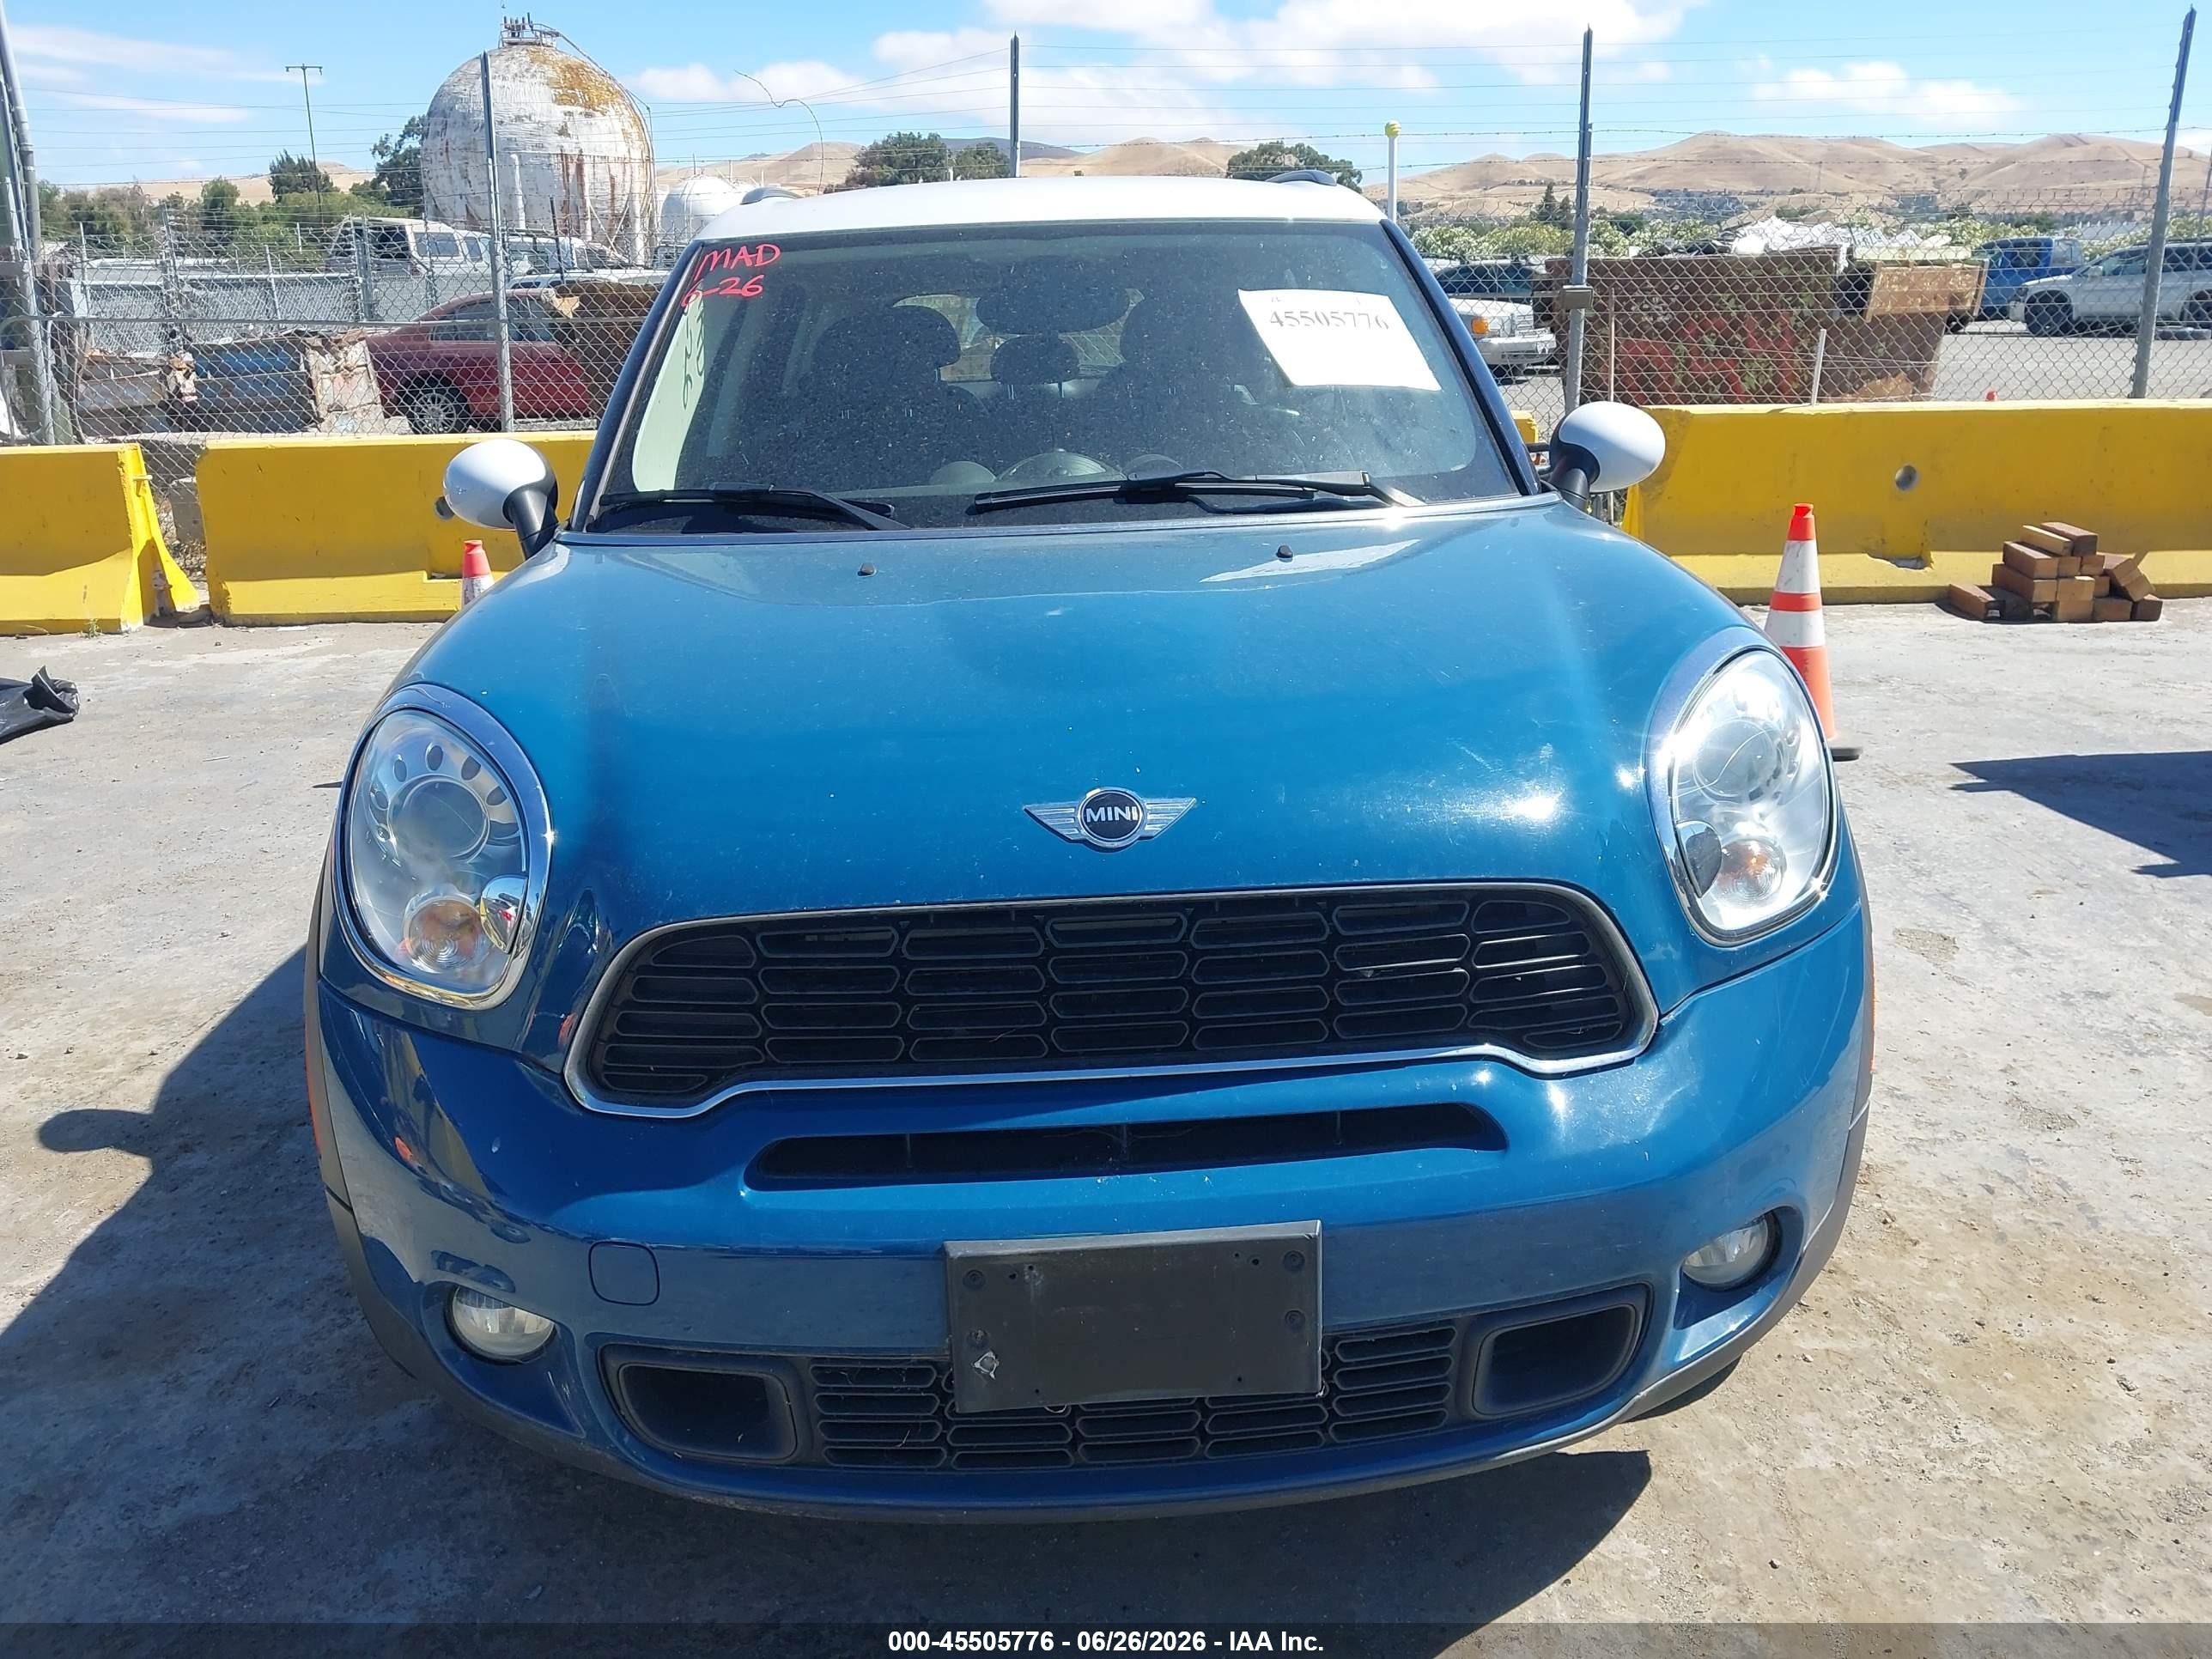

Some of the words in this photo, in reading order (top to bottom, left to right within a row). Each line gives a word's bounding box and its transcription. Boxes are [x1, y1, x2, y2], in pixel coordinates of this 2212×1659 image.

[693, 244, 781, 282] MAD
[680, 274, 765, 307] 6-26
[1270, 310, 1389, 330] 45505776
[1085, 805, 1138, 823] MINI
